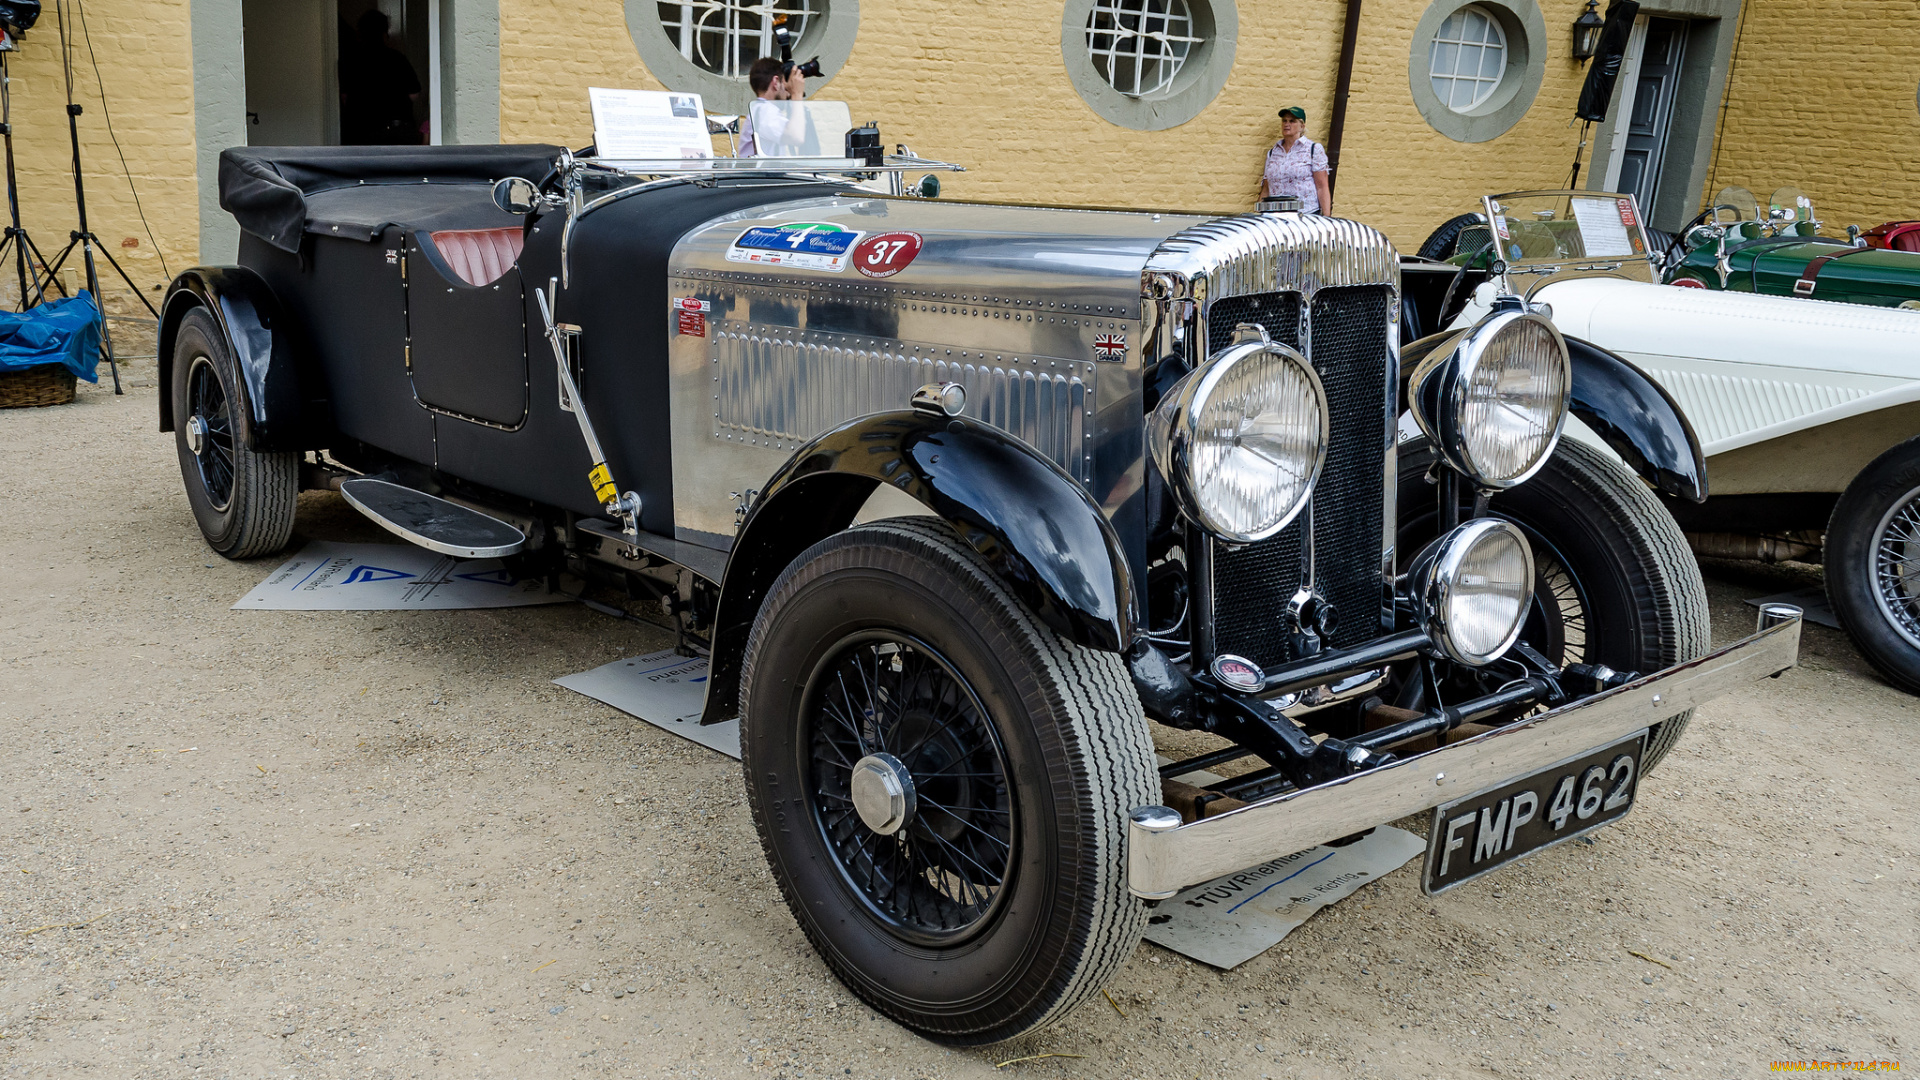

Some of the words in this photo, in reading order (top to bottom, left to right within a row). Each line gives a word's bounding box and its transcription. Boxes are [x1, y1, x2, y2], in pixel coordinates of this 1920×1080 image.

[786, 224, 819, 249] 4
[867, 240, 908, 265] 37
[1440, 790, 1539, 877] FMP
[1547, 754, 1634, 831] 462
